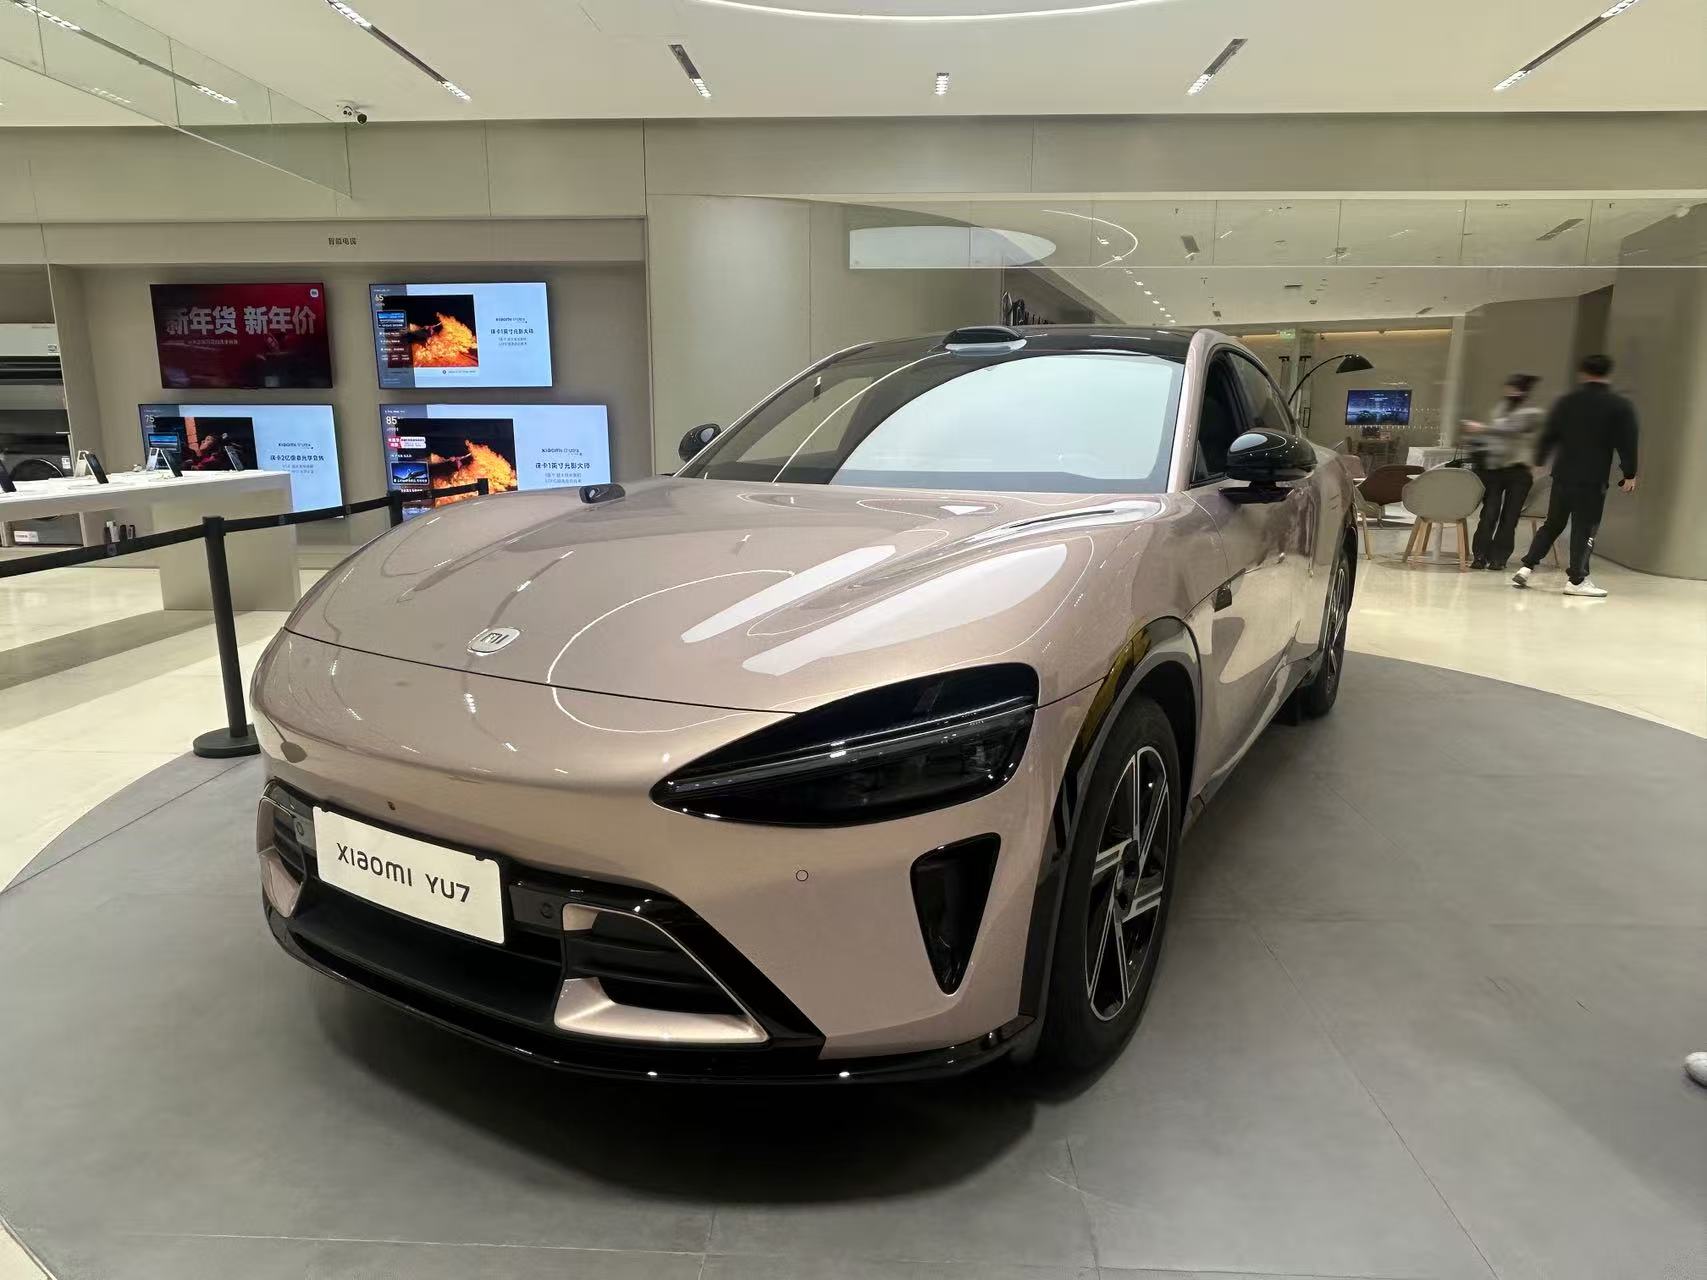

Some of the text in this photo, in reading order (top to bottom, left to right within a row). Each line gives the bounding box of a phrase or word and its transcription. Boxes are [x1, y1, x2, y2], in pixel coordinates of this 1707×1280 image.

[243, 305, 316, 334] 新年价
[144, 415, 155, 423] 75
[385, 416, 397, 425] 85
[424, 873, 470, 903] YU7
